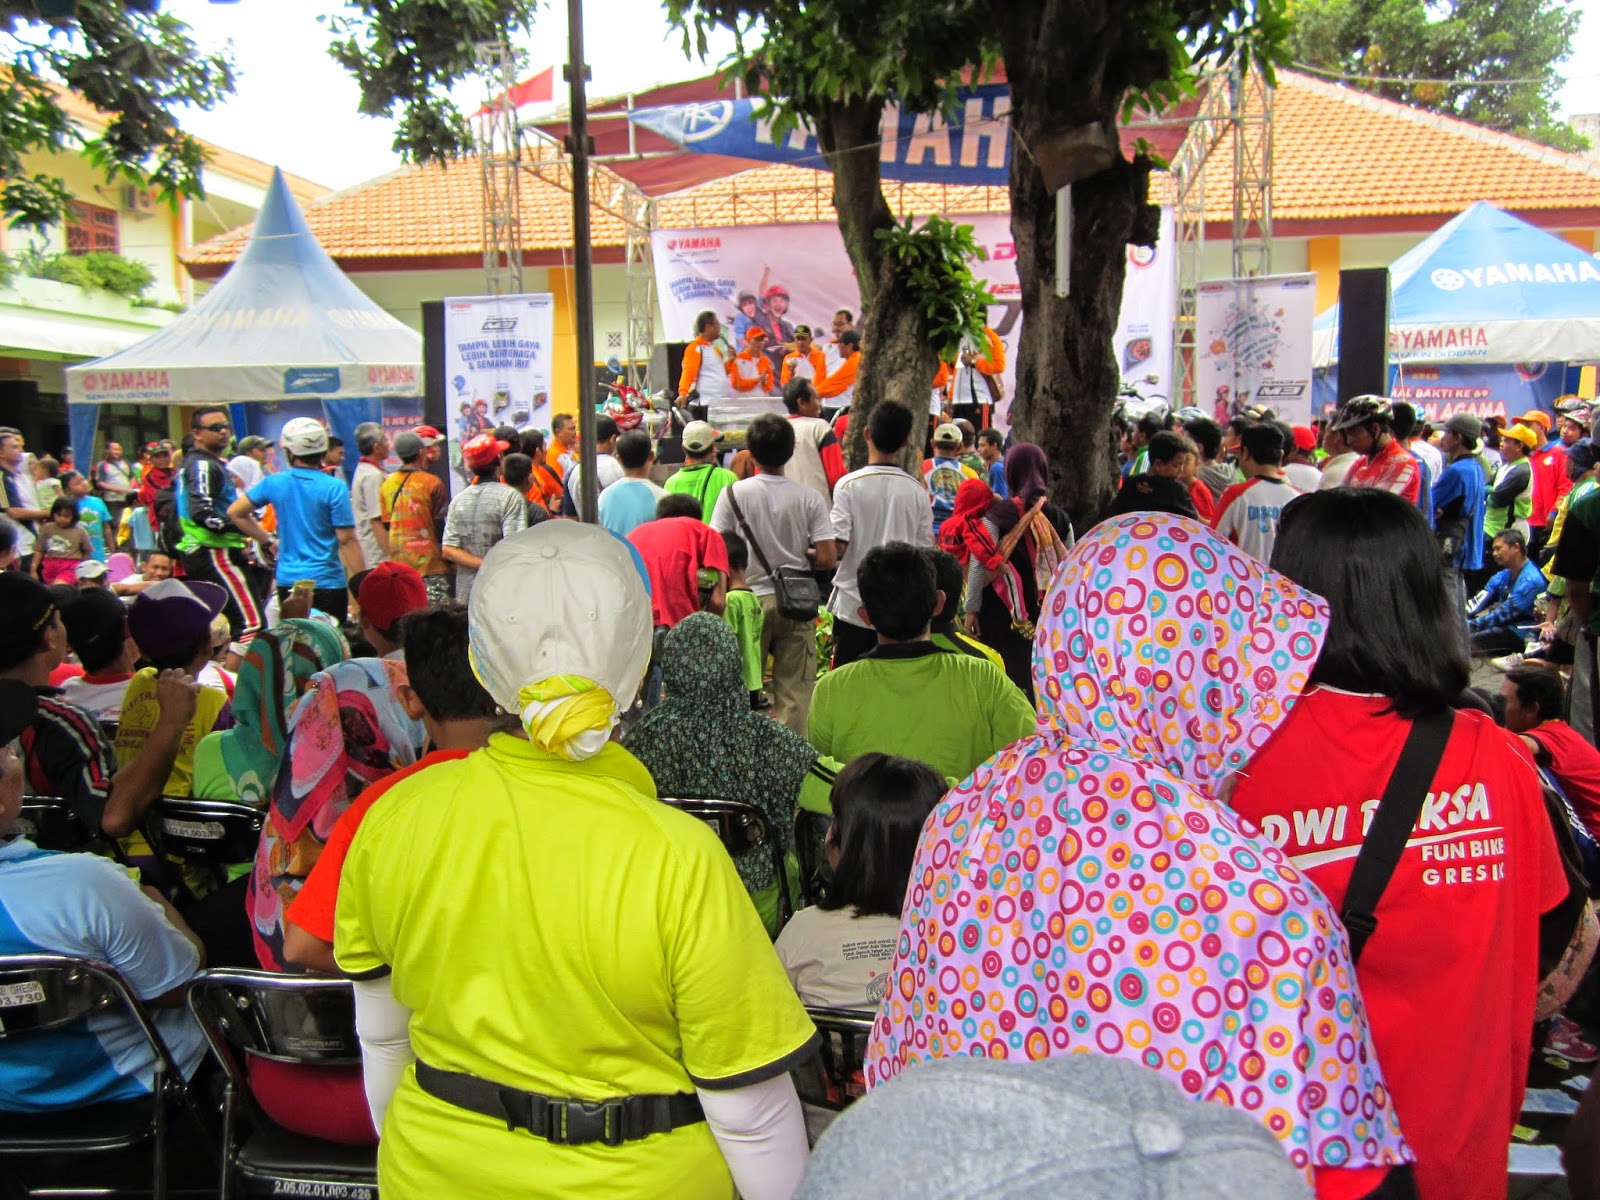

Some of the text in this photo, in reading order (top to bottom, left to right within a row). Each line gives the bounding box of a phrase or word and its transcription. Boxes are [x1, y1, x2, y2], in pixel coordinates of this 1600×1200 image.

[679, 237, 722, 249] YAMAHA
[1461, 261, 1600, 288] YAMAHA
[1401, 328, 1488, 349] YAMAHA
[457, 339, 540, 352] TAMPIL LEBIH GAYA
[461, 349, 536, 361] LEBIH BERTENAGA
[1448, 349, 1487, 358] DEPAN
[476, 359, 512, 369] SEMAKIN
[515, 360, 530, 368] IRIT
[100, 370, 170, 390] YAMAHA
[1415, 388, 1452, 398] BAKTI
[1455, 389, 1471, 398] KE
[1473, 389, 1489, 398] 69
[1261, 806, 1347, 850] DWI
[1421, 837, 1504, 862] FUN BIKE
[1422, 862, 1504, 885] GRESIK
[10, 982, 40, 994] GRESIK
